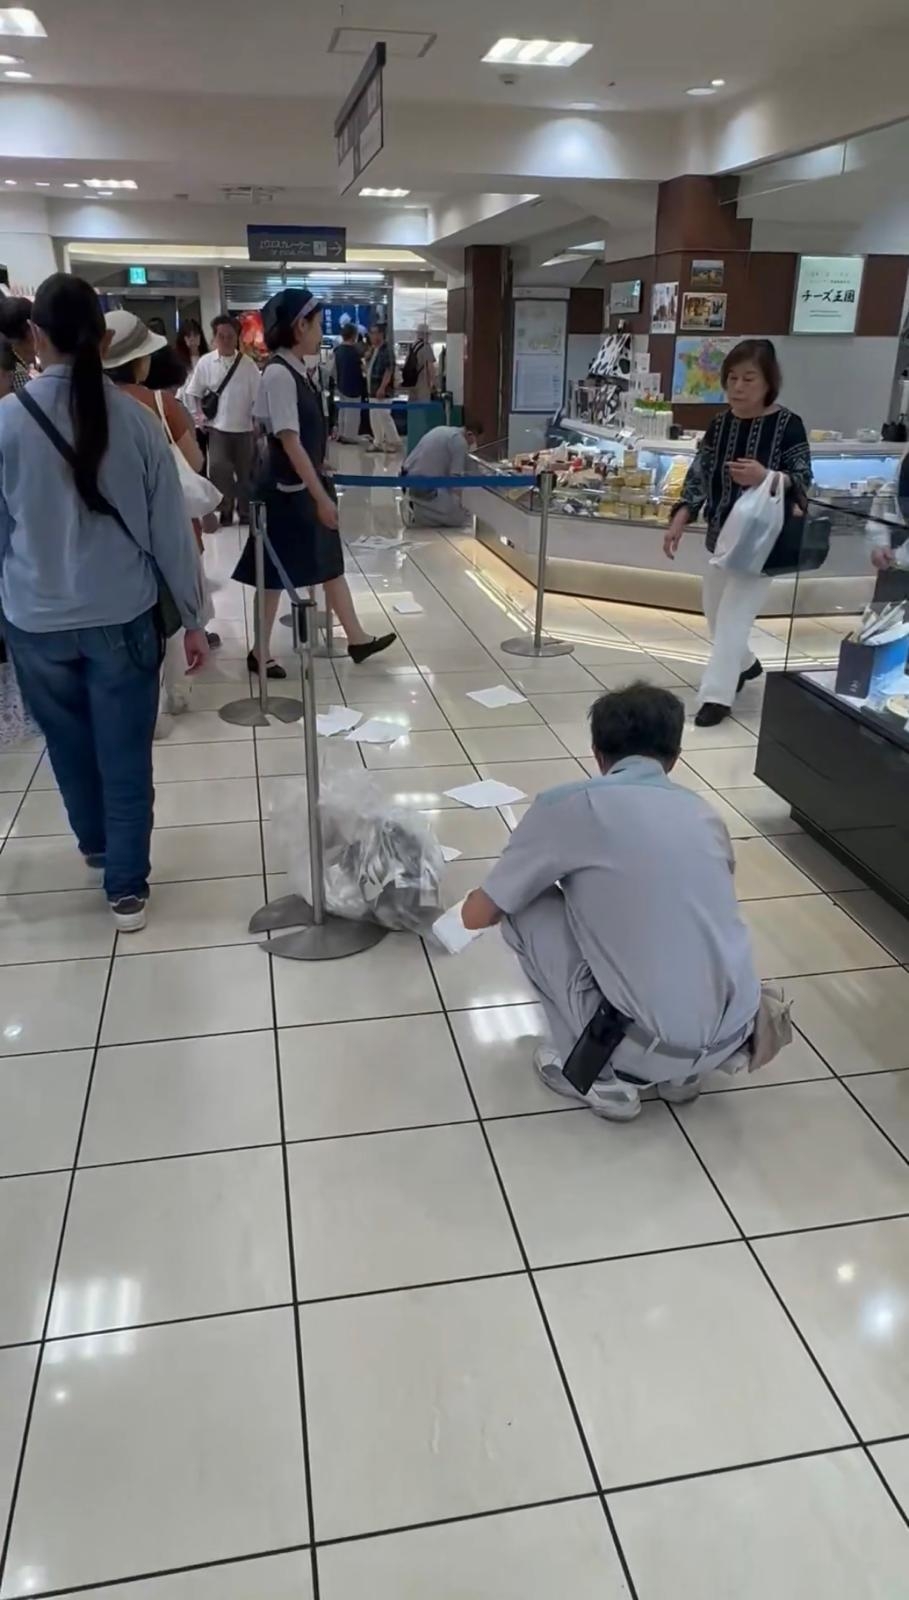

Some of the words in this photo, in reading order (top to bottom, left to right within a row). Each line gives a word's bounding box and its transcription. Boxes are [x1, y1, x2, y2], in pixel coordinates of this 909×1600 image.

[802, 289, 855, 302] チーズ王国
